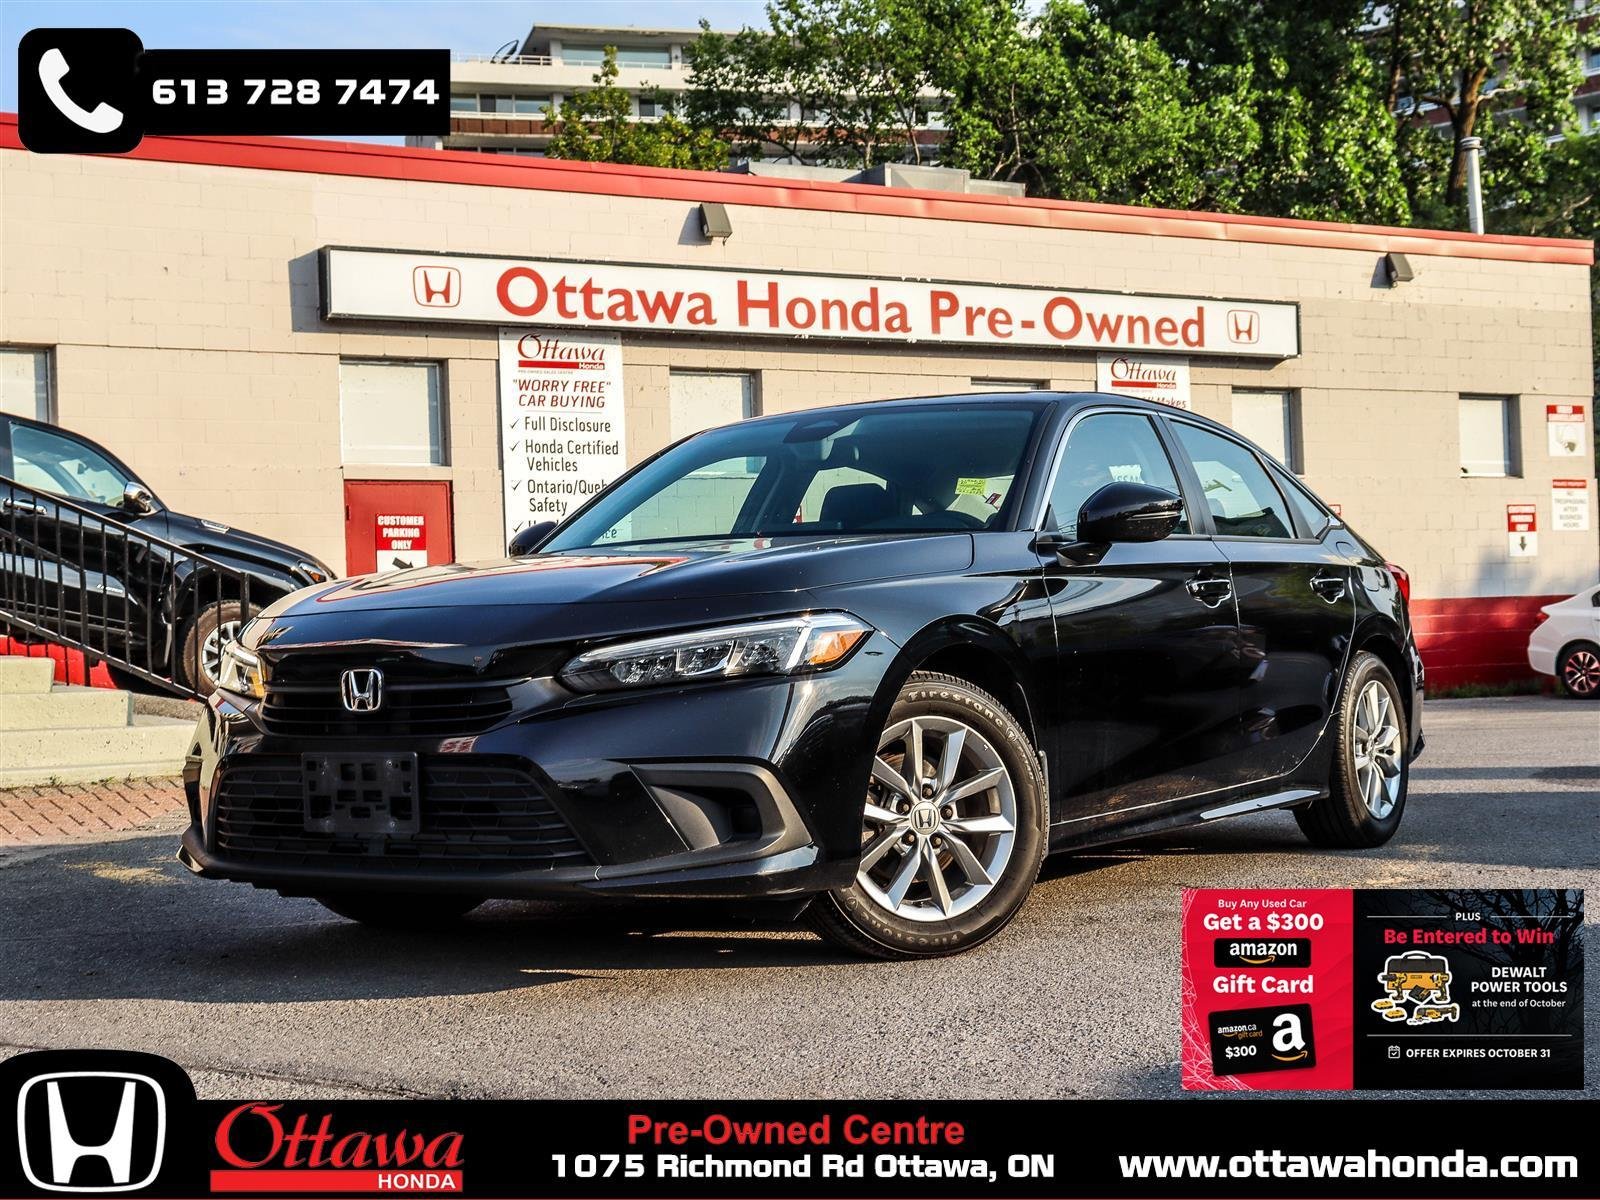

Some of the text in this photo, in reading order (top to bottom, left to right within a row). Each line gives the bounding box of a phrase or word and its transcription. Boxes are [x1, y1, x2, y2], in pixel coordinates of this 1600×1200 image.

[496, 266, 1205, 348] Ottawa Honda Pre-Owned
[517, 333, 605, 361] Ottawa
[579, 362, 605, 370] Honda
[1110, 357, 1177, 381] Ottawa
[513, 378, 611, 393] "WORRY FREE"
[518, 394, 606, 408] CAR BUYING
[525, 416, 611, 433] Full Disclosure
[525, 439, 619, 455] Honda Certified
[527, 457, 578, 472] Vehicles
[527, 479, 608, 496] Ontario/Queb
[529, 497, 568, 517] Safety
[377, 515, 425, 526] CUSTOMER
[382, 527, 420, 538] PARKING
[391, 539, 413, 550] ONLY
[908, 690, 1004, 727] Firestone
